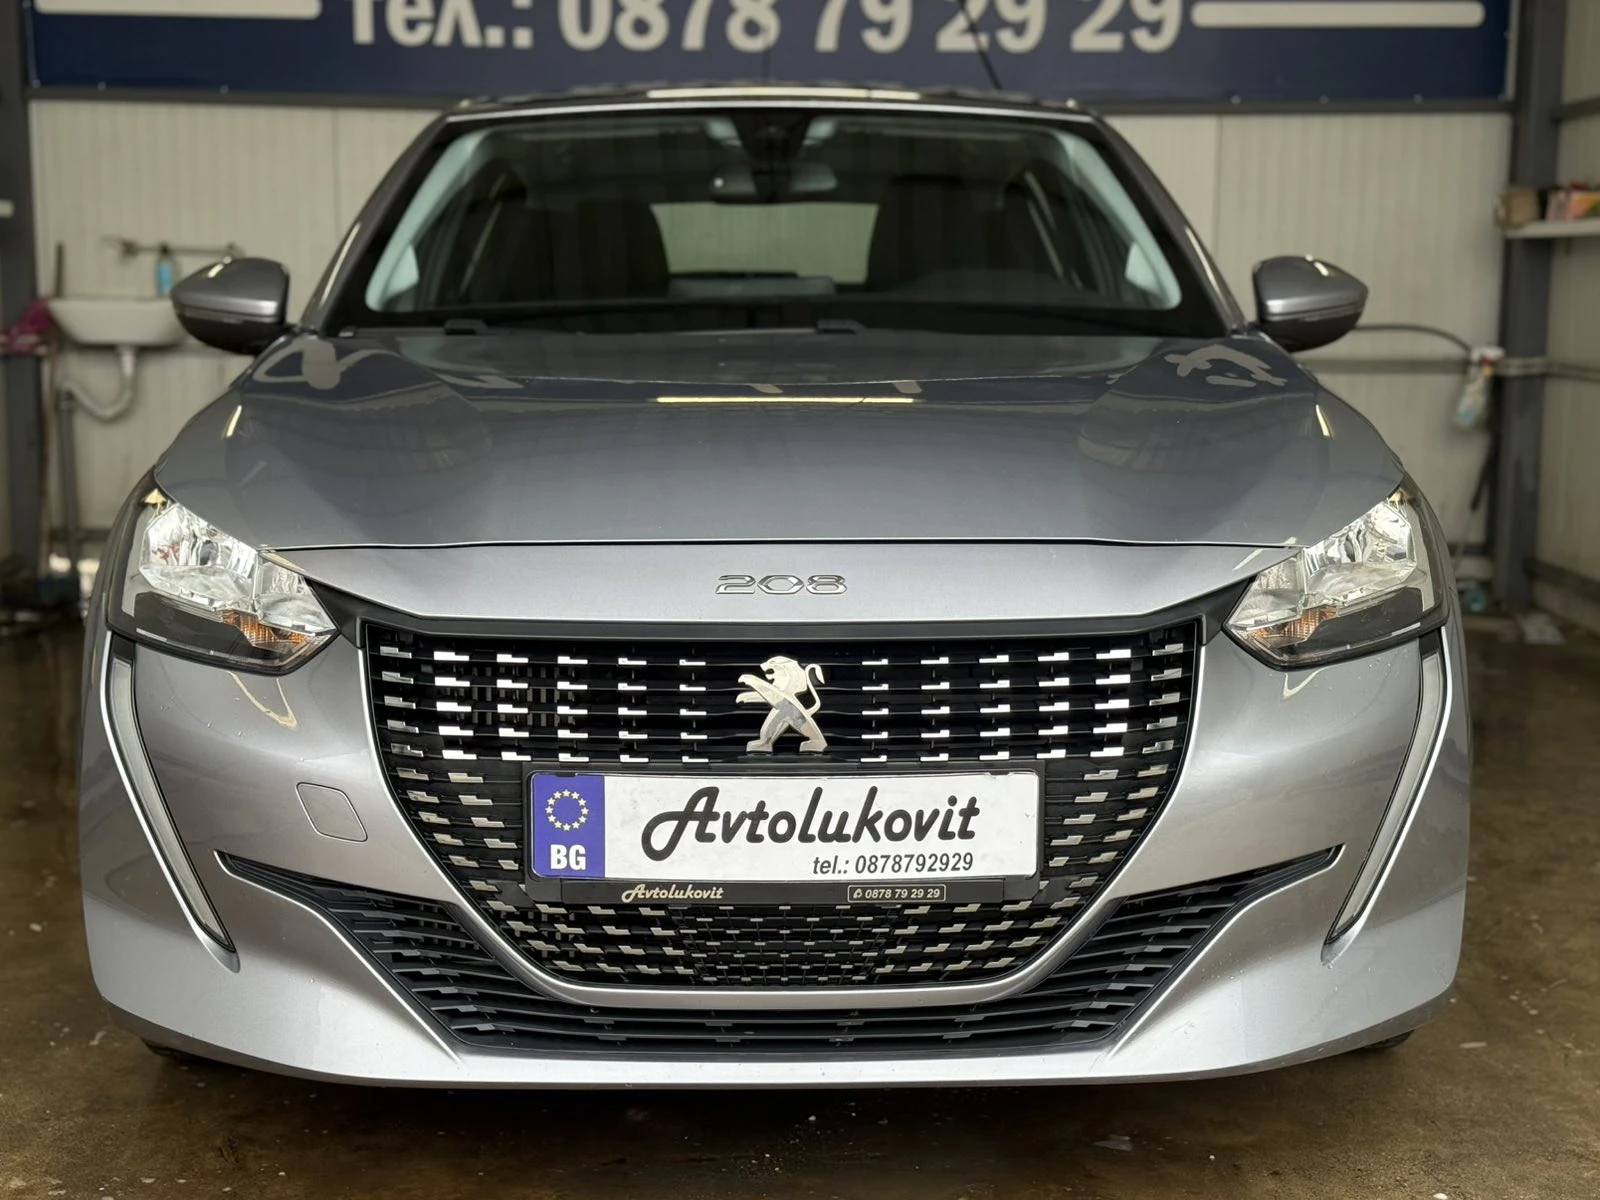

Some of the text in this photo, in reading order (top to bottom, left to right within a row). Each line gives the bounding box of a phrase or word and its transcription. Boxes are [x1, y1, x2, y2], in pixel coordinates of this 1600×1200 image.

[558, 0, 781, 53] 0878
[815, 0, 912, 53] 79
[935, 0, 1047, 53] 29
[1070, 0, 1183, 53] 29
[715, 574, 848, 595] 208
[641, 785, 981, 862] Avtolukovit
[549, 844, 587, 871] BG
[812, 852, 974, 875] tel.: 0878792929
[621, 883, 724, 903] Avtolukovit
[864, 888, 941, 899] 0878 79 29 29
